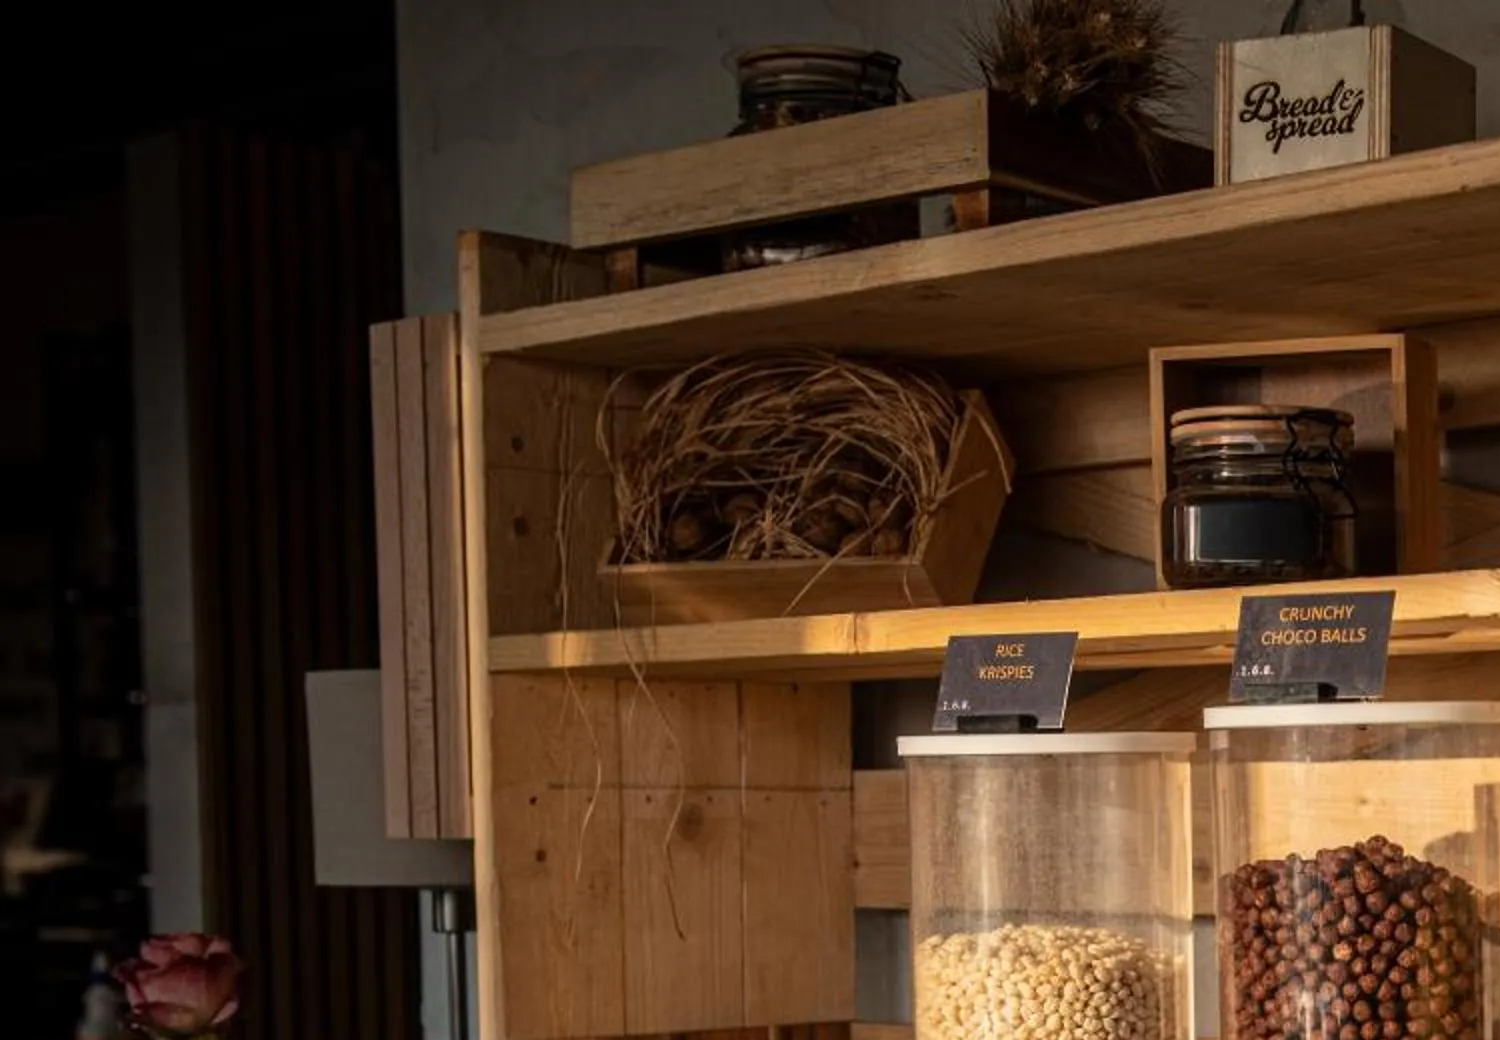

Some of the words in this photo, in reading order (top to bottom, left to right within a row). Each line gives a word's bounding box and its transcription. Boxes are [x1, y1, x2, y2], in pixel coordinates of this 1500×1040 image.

[1239, 79, 1345, 122] Bread
[1265, 96, 1364, 154] spread
[1279, 604, 1355, 622] CRUNCHY
[1261, 629, 1317, 645] CHOCO
[1321, 627, 1367, 643] BALLS
[995, 643, 1025, 657] RICE
[978, 665, 1035, 680] KRISPIES
